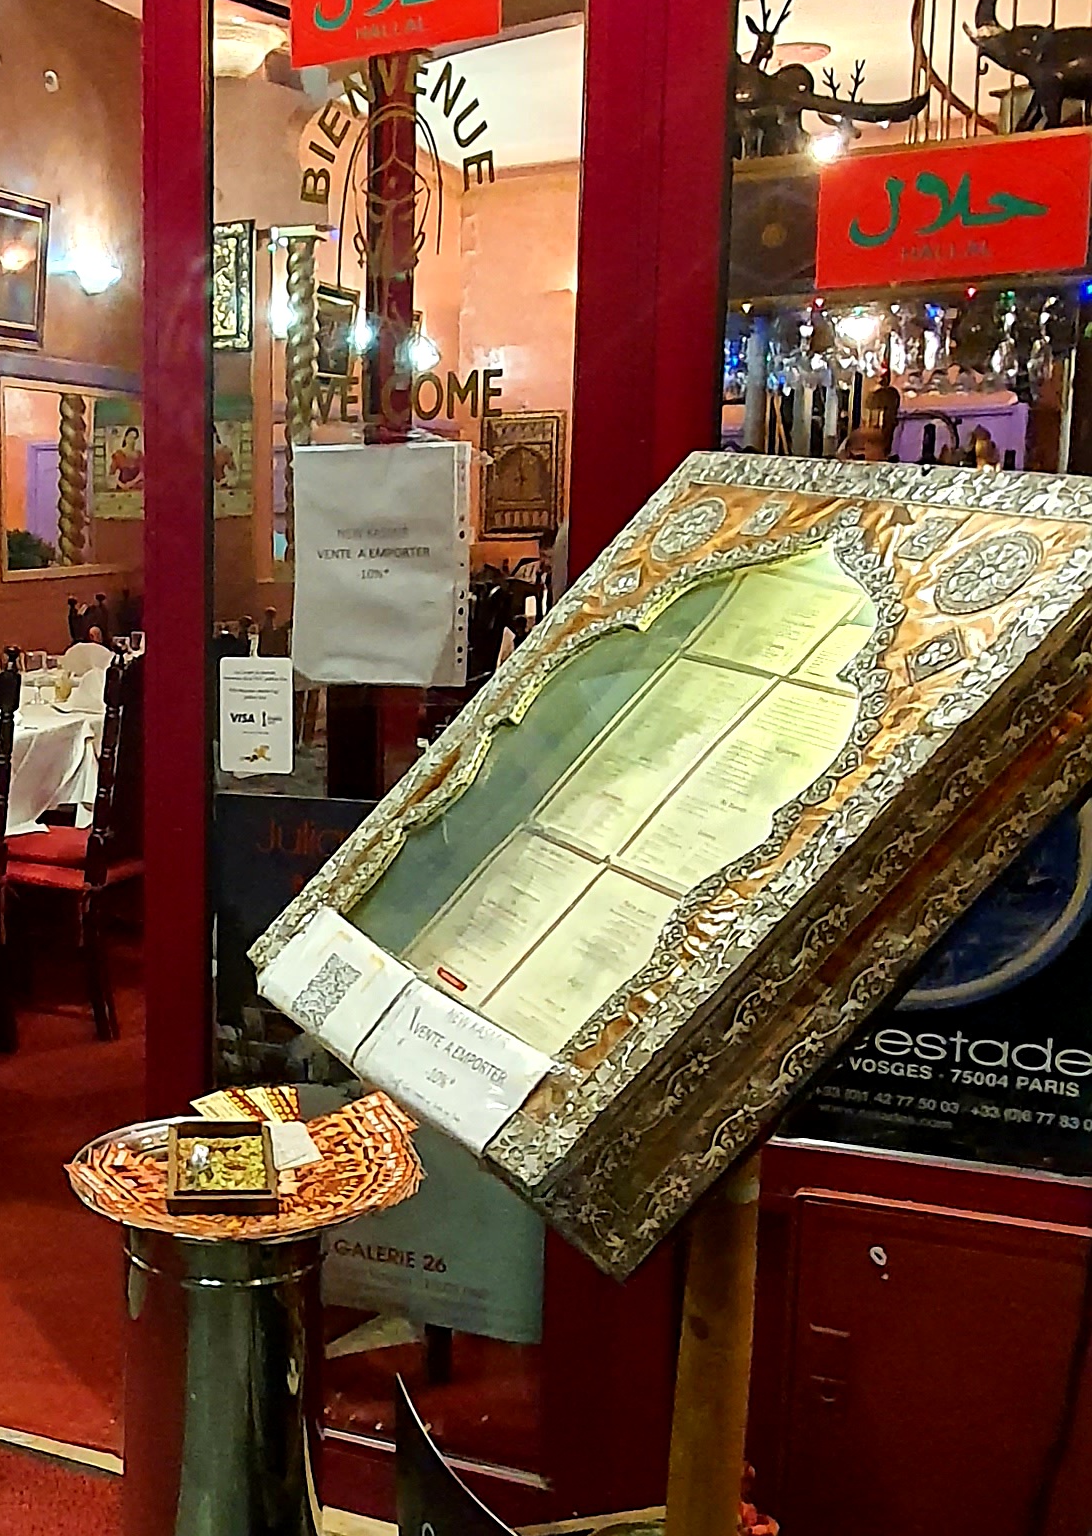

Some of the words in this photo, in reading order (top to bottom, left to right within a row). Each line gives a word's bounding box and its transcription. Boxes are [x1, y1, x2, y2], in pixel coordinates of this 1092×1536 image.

[300, 52, 496, 206] BIENVENUE
[848, 170, 1049, 247] حلال
[291, 366, 505, 424] WELCOME
[317, 548, 352, 560] VENTE
[357, 548, 366, 559] A
[368, 546, 431, 560] EMPORTER
[230, 712, 256, 724] VISA
[413, 1022, 446, 1049] VENTE
[451, 1045, 509, 1087] EMPORTER
[849, 1056, 933, 1080] VOSGES
[950, 1068, 1008, 1089] 75004
[1015, 1075, 1081, 1098] PARIS
[874, 1091, 892, 1105] 42
[896, 1094, 915, 1107] 77
[918, 1097, 937, 1111] 50
[940, 1100, 960, 1114] 03
[1035, 1111, 1056, 1125] 77
[1059, 1115, 1080, 1130] 83
[333, 1238, 416, 1269] GALERIE
[423, 1253, 448, 1274] 26
